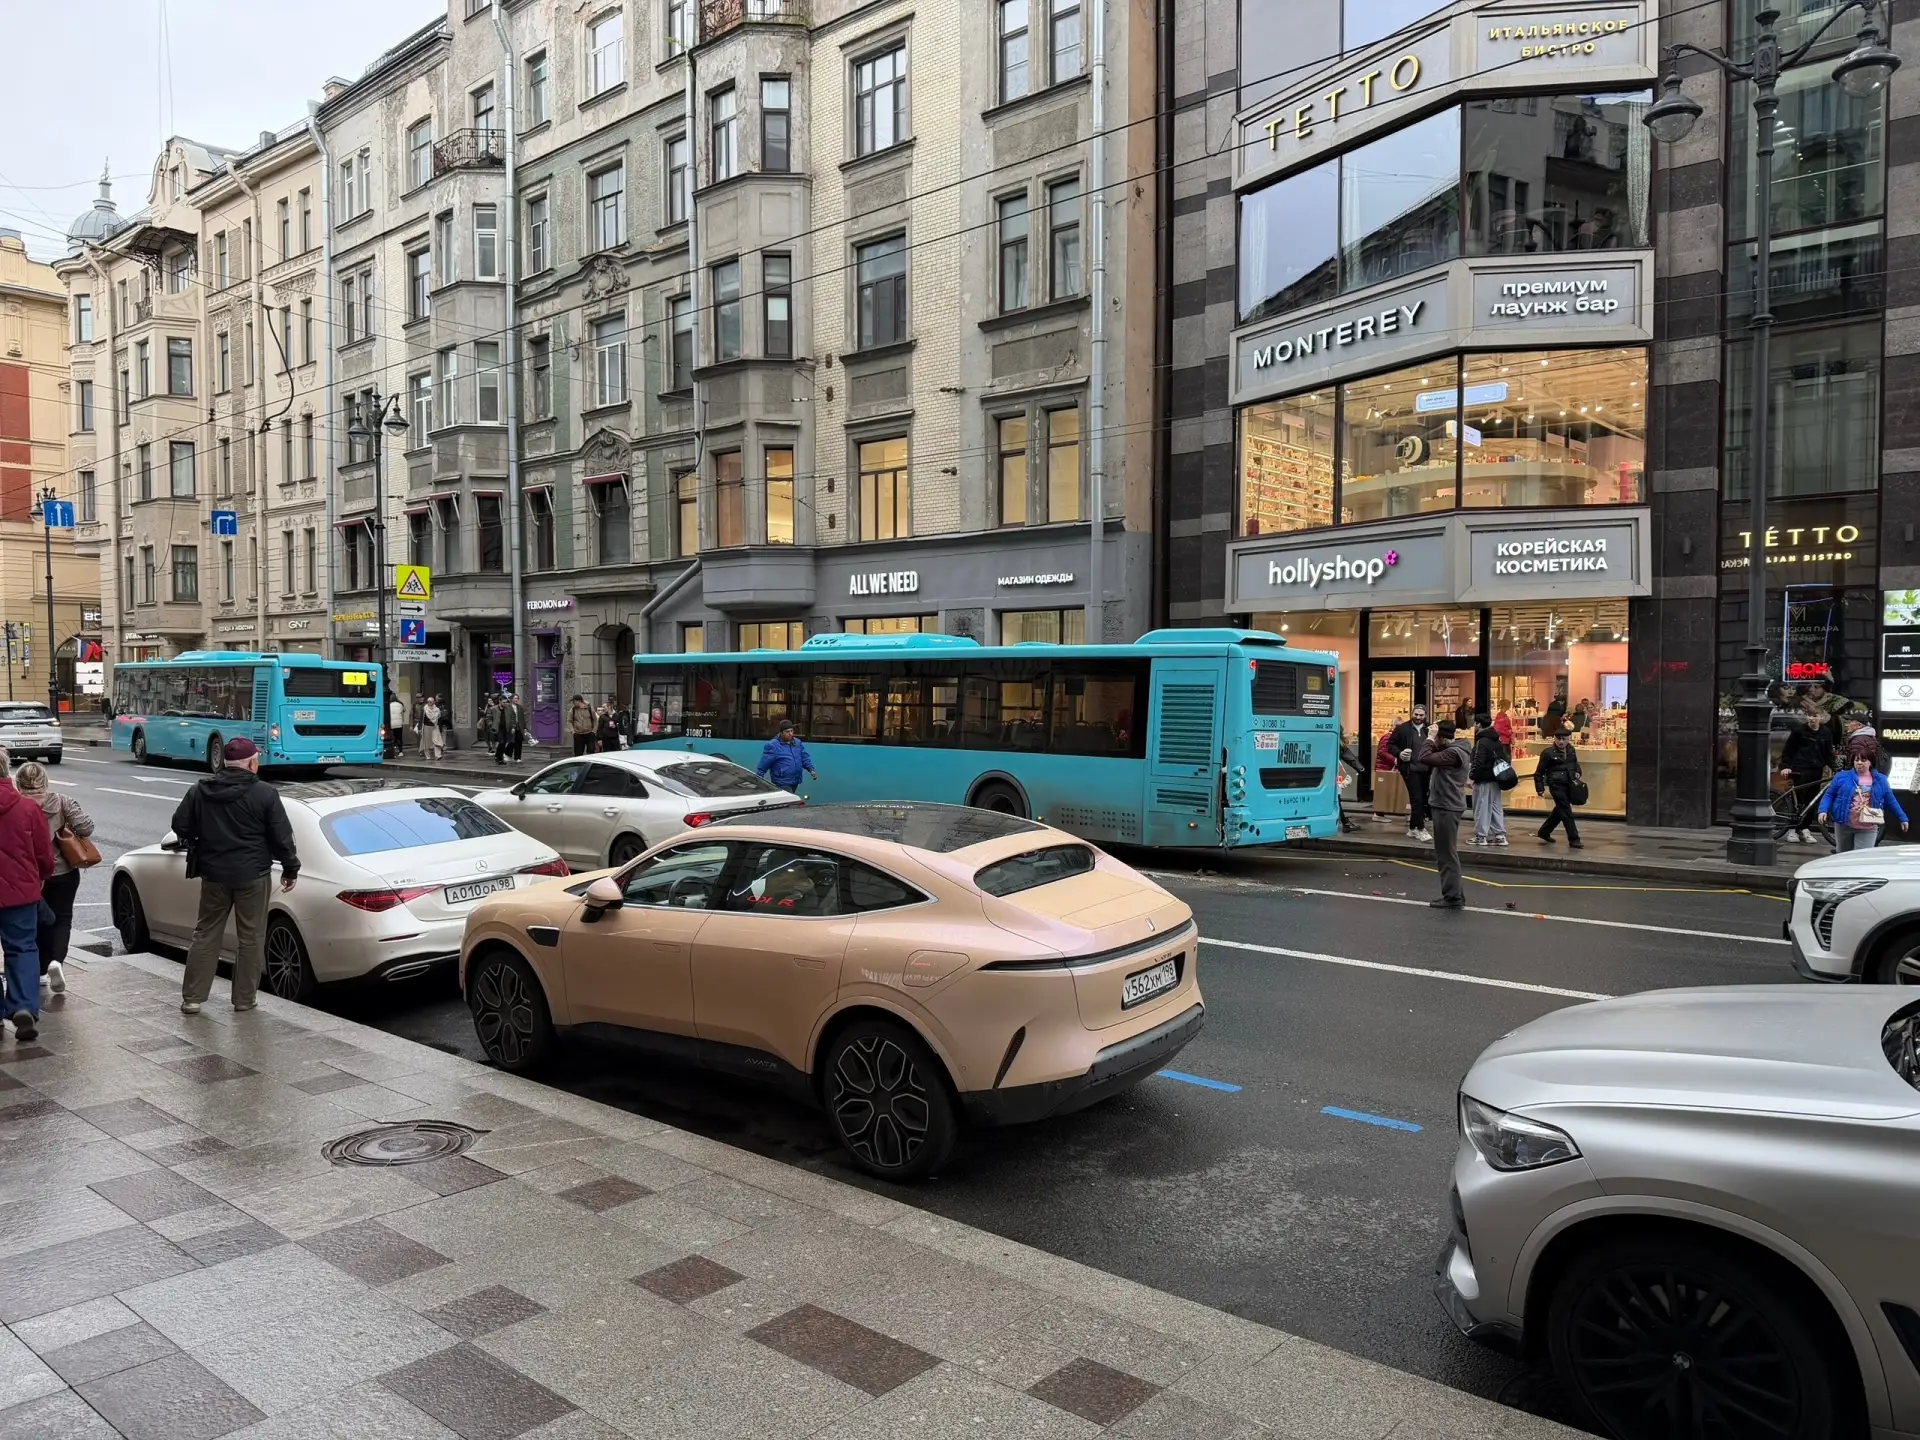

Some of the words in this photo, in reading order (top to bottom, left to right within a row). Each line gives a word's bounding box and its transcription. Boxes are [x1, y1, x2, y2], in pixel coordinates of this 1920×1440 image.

[1489, 20, 1628, 39] ИТАЛЬЯНСКОЕ
[1521, 42, 1595, 58] БИСТРО
[1263, 55, 1421, 151] TETTO
[1502, 279, 1607, 296] премиум
[1491, 298, 1568, 317] лаунж
[1575, 296, 1618, 315] бар
[1253, 301, 1425, 369] MONTEREY
[1497, 537, 1607, 556] КОРЕЙСКАЯ
[1496, 557, 1608, 574] КОСМЕТИКА
[1803, 552, 1852, 562] BISTRO
[997, 574, 1034, 586] МАГАЗИН
[1034, 572, 1073, 584] ОДЕЖДЫ
[1268, 554, 1384, 588] hollyshop
[849, 574, 869, 595] ALL
[869, 572, 888, 594] WE
[888, 571, 919, 593] NEED
[527, 599, 558, 610] FEROMON
[288, 620, 309, 630] GNT
[1262, 719, 1278, 728] 31080
[1279, 719, 1286, 728] 12
[685, 728, 703, 737] 31080
[704, 729, 712, 738] 12
[451, 884, 498, 901] А010ОА
[1124, 973, 1162, 1000] У562ХМ
[1161, 962, 1174, 980] 198
